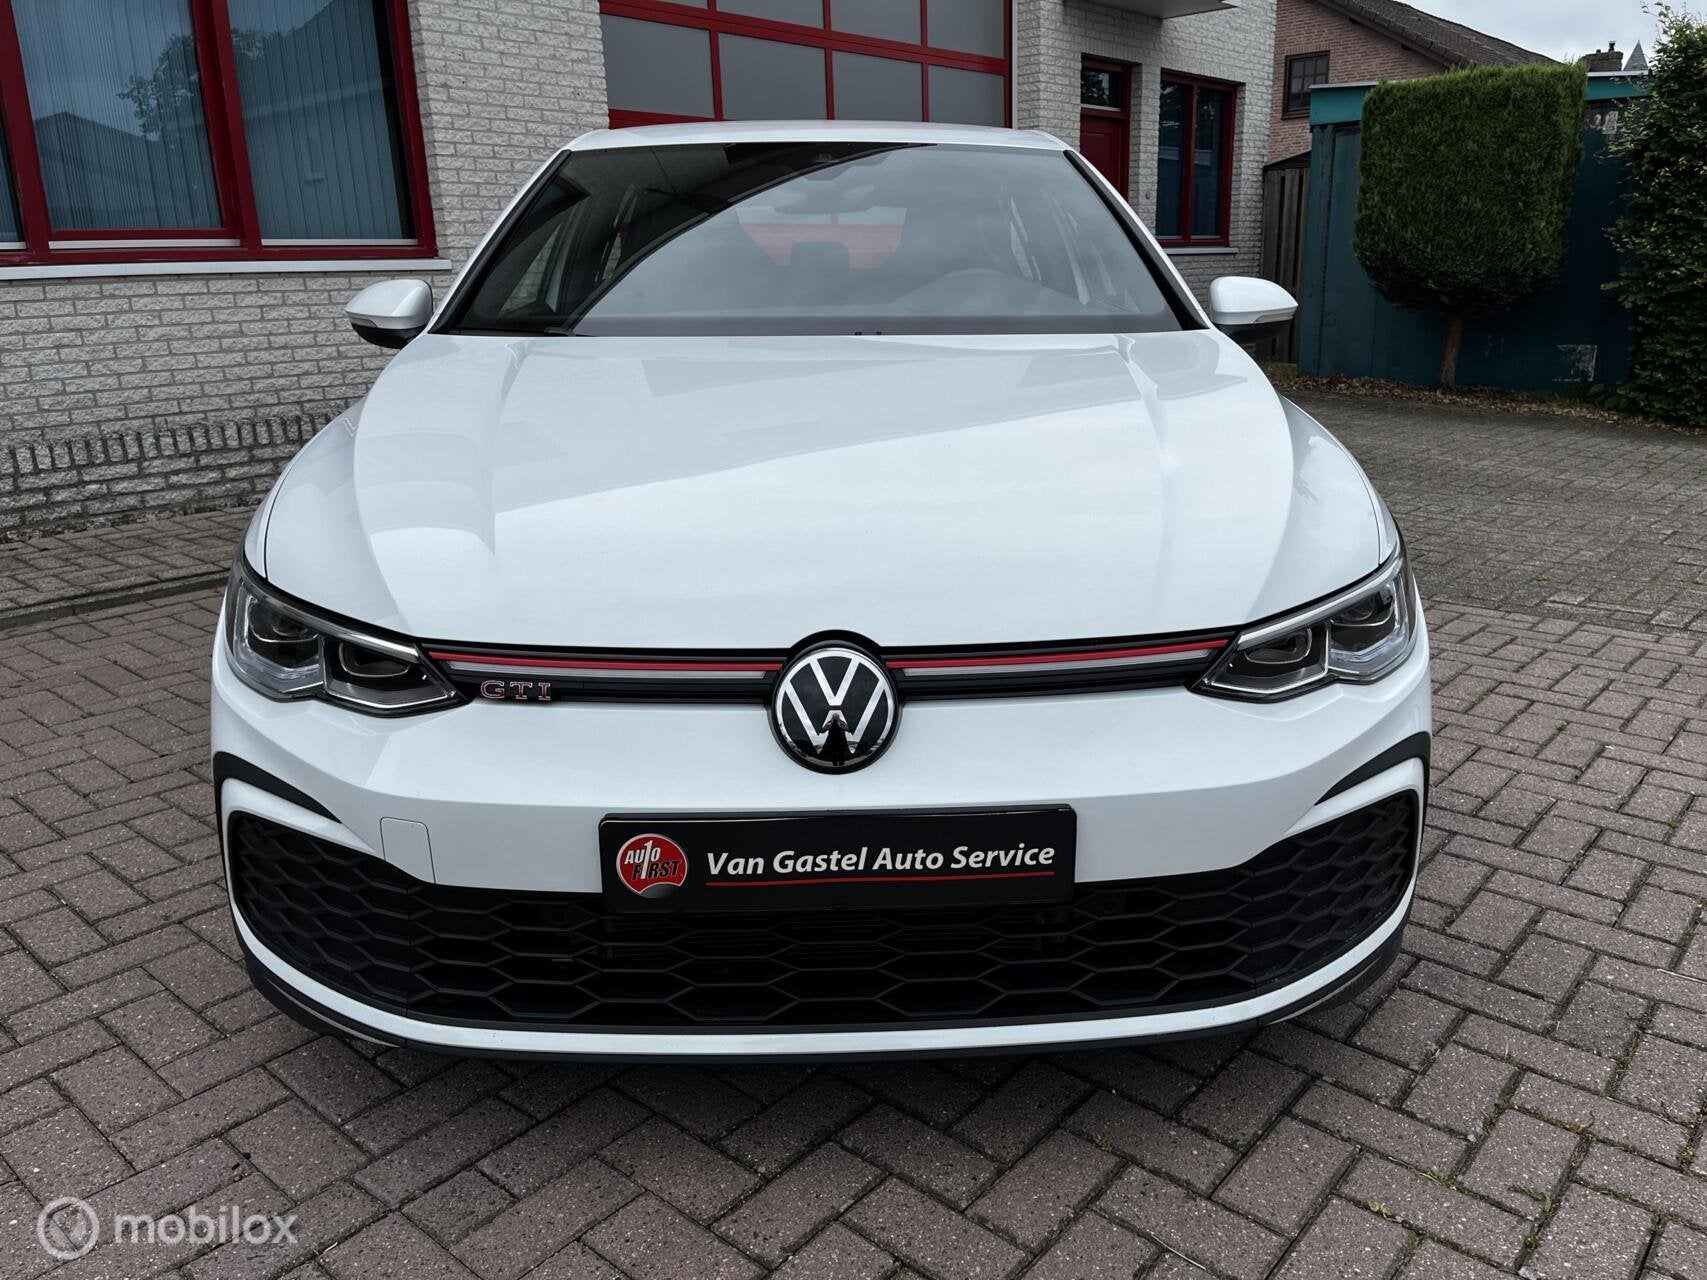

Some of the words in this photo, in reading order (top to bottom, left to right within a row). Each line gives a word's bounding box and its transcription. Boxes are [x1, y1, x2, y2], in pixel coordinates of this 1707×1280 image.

[480, 680, 551, 701] GTI
[707, 852, 765, 875] Van
[773, 846, 868, 874] Gastel
[872, 847, 944, 870] Auto
[950, 843, 1055, 869] Service
